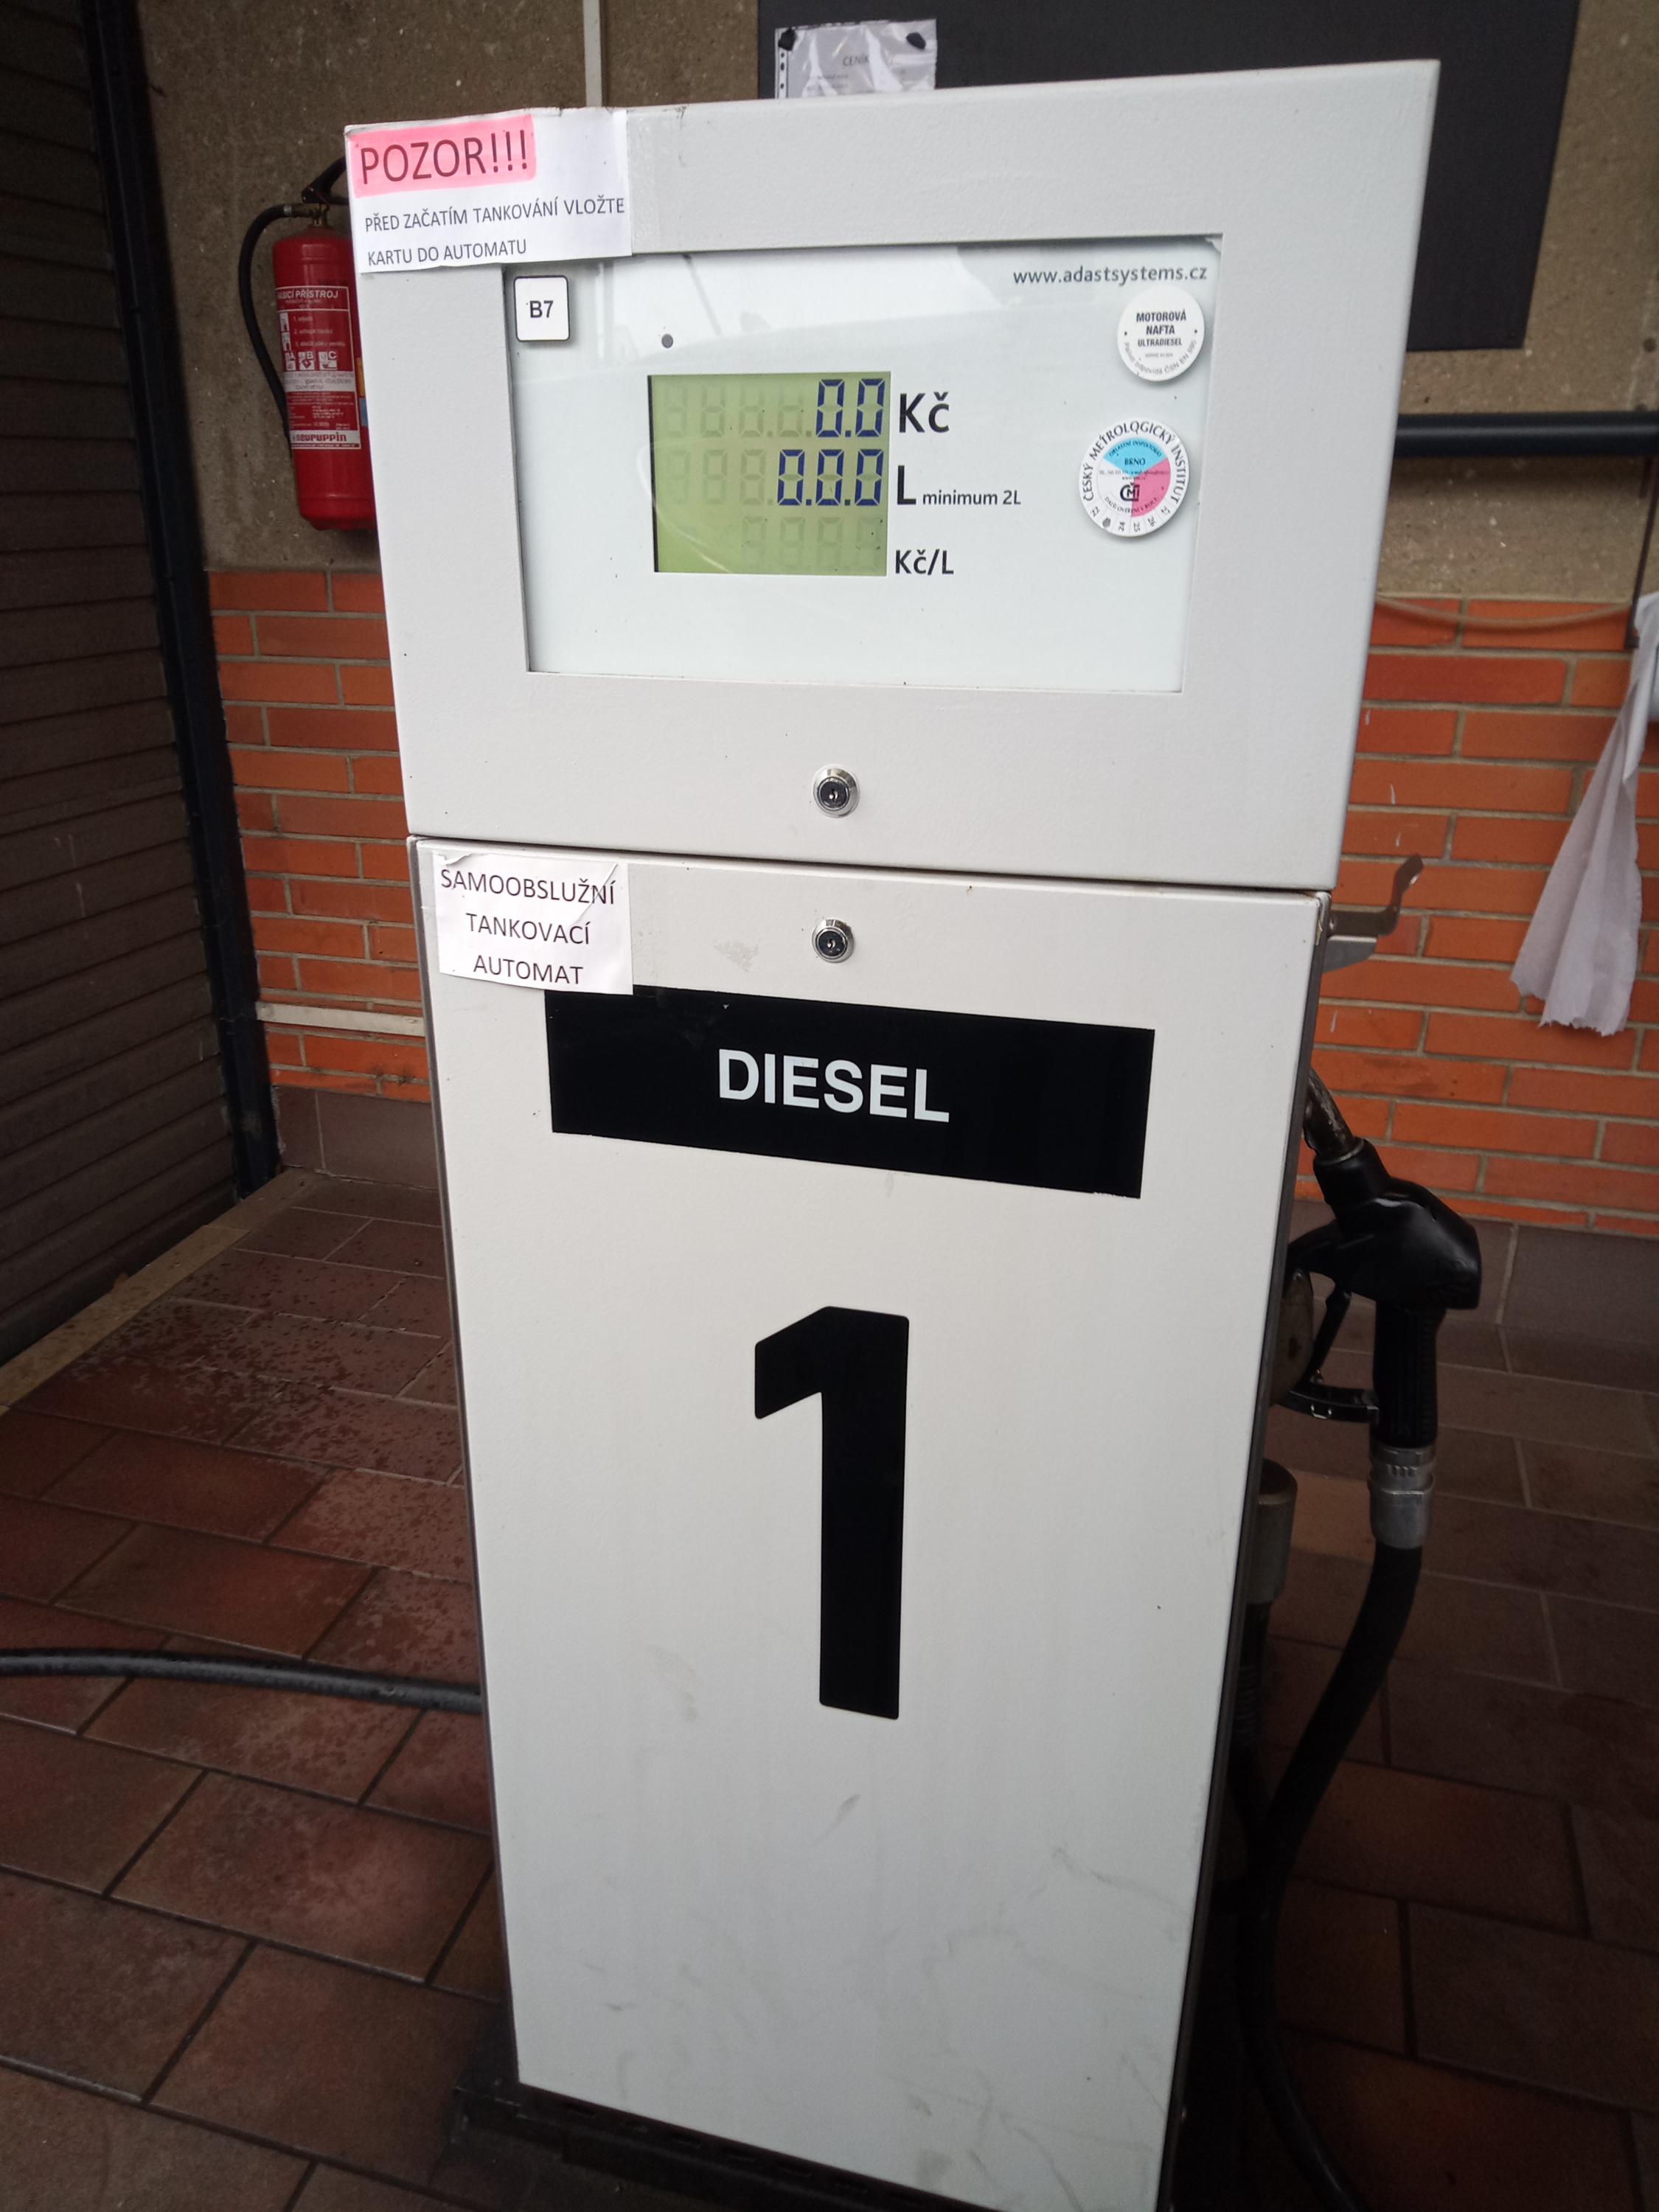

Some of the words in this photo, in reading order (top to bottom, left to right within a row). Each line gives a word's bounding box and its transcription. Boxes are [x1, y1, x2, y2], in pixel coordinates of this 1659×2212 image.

[360, 129, 528, 185] POZOR!!!
[365, 213, 399, 232] PŘED
[403, 208, 467, 229] ZAČATÍM
[472, 196, 558, 223] TANKOVÁNÍ
[563, 195, 625, 215] VLOŽTE
[368, 248, 412, 266] KARTU
[417, 246, 439, 262] DO
[443, 239, 527, 260] AUTOMATU
[1013, 265, 1208, 286] www.adastsystems.cz
[529, 300, 554, 319] B7
[1136, 308, 1186, 322] MOTOROVÁ
[1138, 338, 1182, 347] ULTRADIESEL
[1146, 324, 1175, 335] NAFTA
[898, 391, 950, 434] Kč
[1124, 457, 1146, 466] BRNO
[1171, 445, 1186, 504] INSTITUT
[897, 465, 917, 505] L
[922, 490, 998, 505] minimum
[1003, 491, 1020, 505] 2L
[894, 549, 954, 577] Kč/L
[441, 869, 616, 904] SAMOOBSLUŽNÍ
[466, 913, 591, 945] TANKOVACÍ
[473, 956, 584, 985] AUTOMAT
[719, 1048, 950, 1123] DIESEL
[755, 1306, 909, 1719] 1
